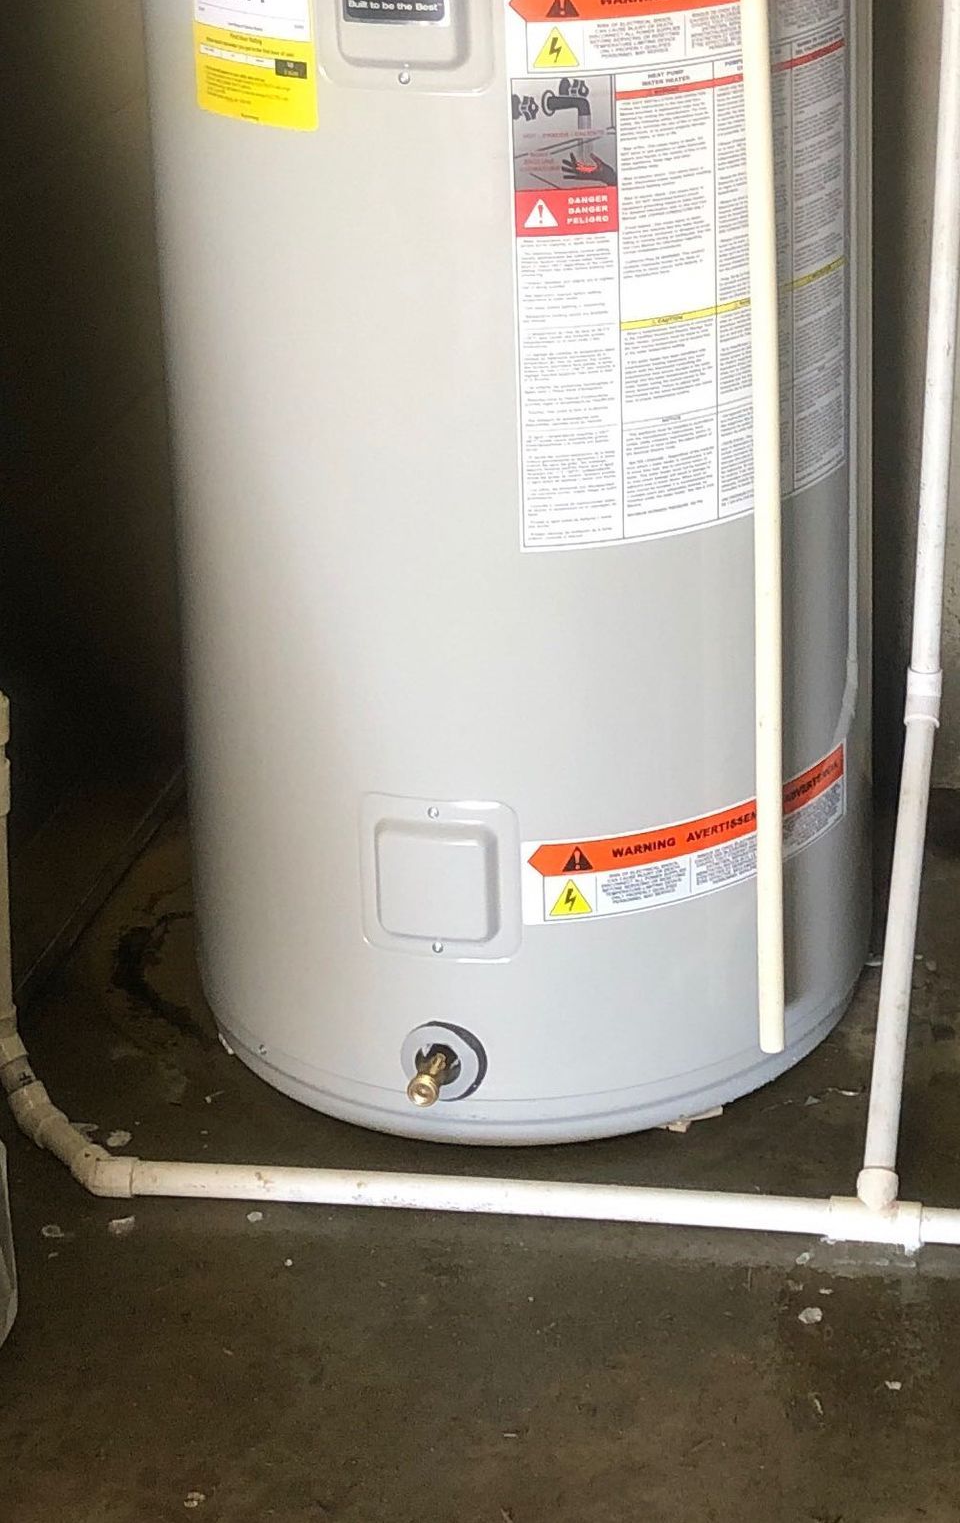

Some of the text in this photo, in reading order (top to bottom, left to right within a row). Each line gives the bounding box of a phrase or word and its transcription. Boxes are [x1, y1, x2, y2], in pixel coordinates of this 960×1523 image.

[348, 0, 368, 9] Built
[370, 1, 380, 10] to
[382, 2, 395, 10] be
[397, 3, 412, 11] the
[568, 195, 608, 204] DANGER
[568, 206, 608, 214] DANGER
[567, 216, 609, 225] PELIGRO
[612, 838, 676, 858] WARNING
